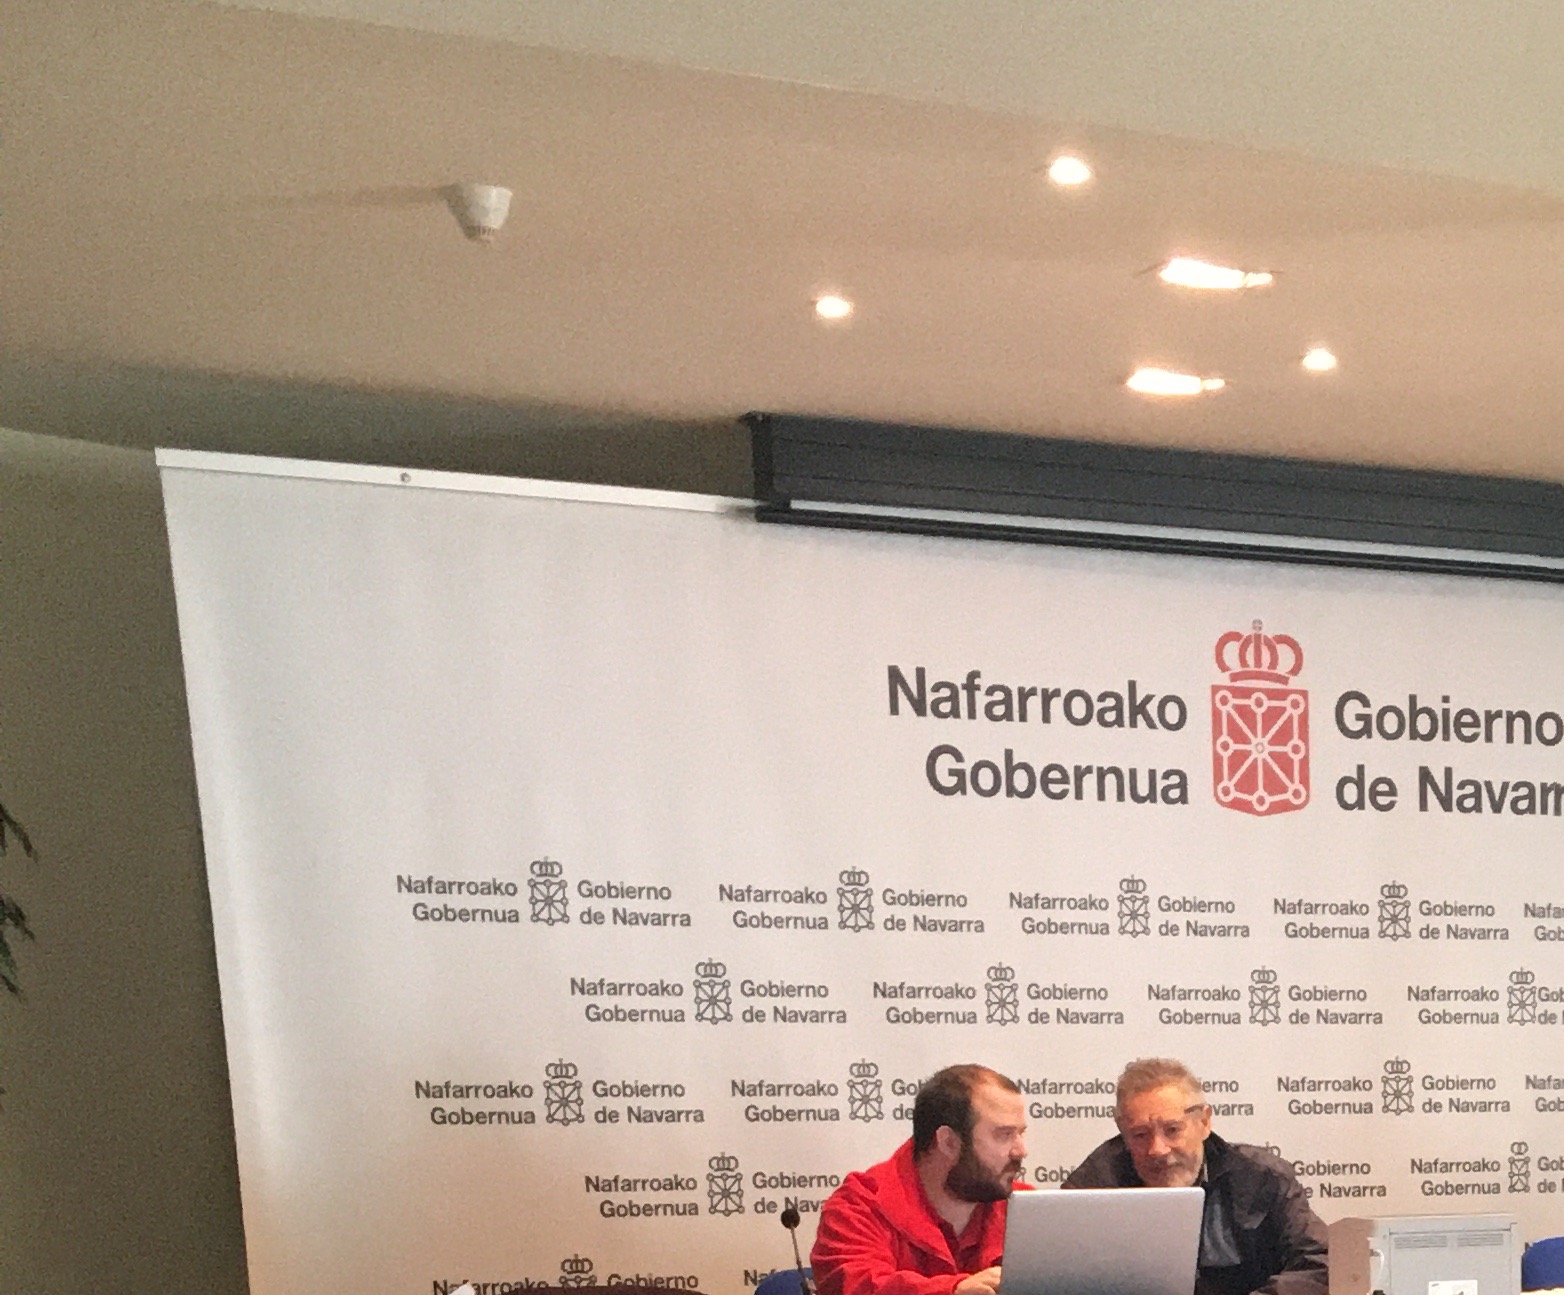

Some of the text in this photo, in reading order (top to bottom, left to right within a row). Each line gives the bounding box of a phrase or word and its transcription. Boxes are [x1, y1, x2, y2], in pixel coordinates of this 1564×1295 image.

[888, 665, 1187, 731] Nafarroako
[1335, 691, 1564, 746] Gobierno
[926, 744, 1188, 805] Gobernua
[1336, 764, 1398, 812] de
[397, 875, 518, 896] Nafarroako
[577, 880, 671, 900] Gobierno
[719, 884, 827, 904] Nafarroako
[882, 888, 967, 907] Gobierno
[1009, 892, 1109, 911] Nafarroako
[1158, 895, 1235, 913] Gobierno
[413, 903, 519, 923] Gobernua
[1274, 898, 1369, 916] Nafarroako
[1419, 900, 1495, 917] Gobierno
[580, 906, 691, 927] de Navarra
[733, 910, 828, 930] Gobernua
[884, 914, 984, 933] de Navarra
[1022, 917, 1109, 935] Gobernua
[1159, 920, 1250, 938] de Navarra
[1285, 922, 1369, 939] Gobernua
[1419, 924, 1509, 940] de Navarra
[571, 978, 683, 996] Nafarroako
[741, 980, 828, 998] Gobierno
[873, 982, 976, 999] Nafarroako
[1027, 983, 1108, 1000] Gobierno
[1148, 984, 1240, 1001] Nafarroako
[1288, 985, 1367, 1001] Gobierno
[1408, 986, 1499, 1002] Nafarroako
[585, 1004, 685, 1022] Gobernua
[742, 1006, 846, 1023] de Navarra
[886, 1006, 977, 1024] Gobernua
[1028, 1008, 1124, 1024] de Navarra
[1159, 1008, 1241, 1025] Gobernua
[1289, 1008, 1382, 1025] de Navarra
[1418, 1008, 1499, 1024] Gobernua
[1538, 1009, 1558, 1025] de
[415, 1081, 533, 1099] Nafarroako
[592, 1080, 685, 1098] Gobierno
[731, 1080, 838, 1097] Nafarroako
[1018, 1079, 1115, 1095] Nafarroako
[1278, 1076, 1373, 1092] Nafarroako
[1422, 1075, 1496, 1090] Gobierno
[745, 1104, 840, 1122] Gobernua
[1029, 1102, 1115, 1119] Gobernua
[1288, 1099, 1373, 1115] Gobernua
[1422, 1098, 1510, 1113] de Navarra
[431, 1107, 535, 1125] Gobernua
[594, 1106, 705, 1123] de Navarra
[1293, 1160, 1371, 1176] Gobierno
[1411, 1158, 1500, 1174] Nafarroako
[585, 1175, 697, 1193] Nafarroako
[752, 1172, 840, 1189] Gobierno
[1421, 1180, 1500, 1196] Gobernua
[1537, 1179, 1557, 1193] de
[1320, 1183, 1386, 1198] Navarra
[600, 1200, 698, 1218] Gobernua
[754, 1197, 777, 1214] de
